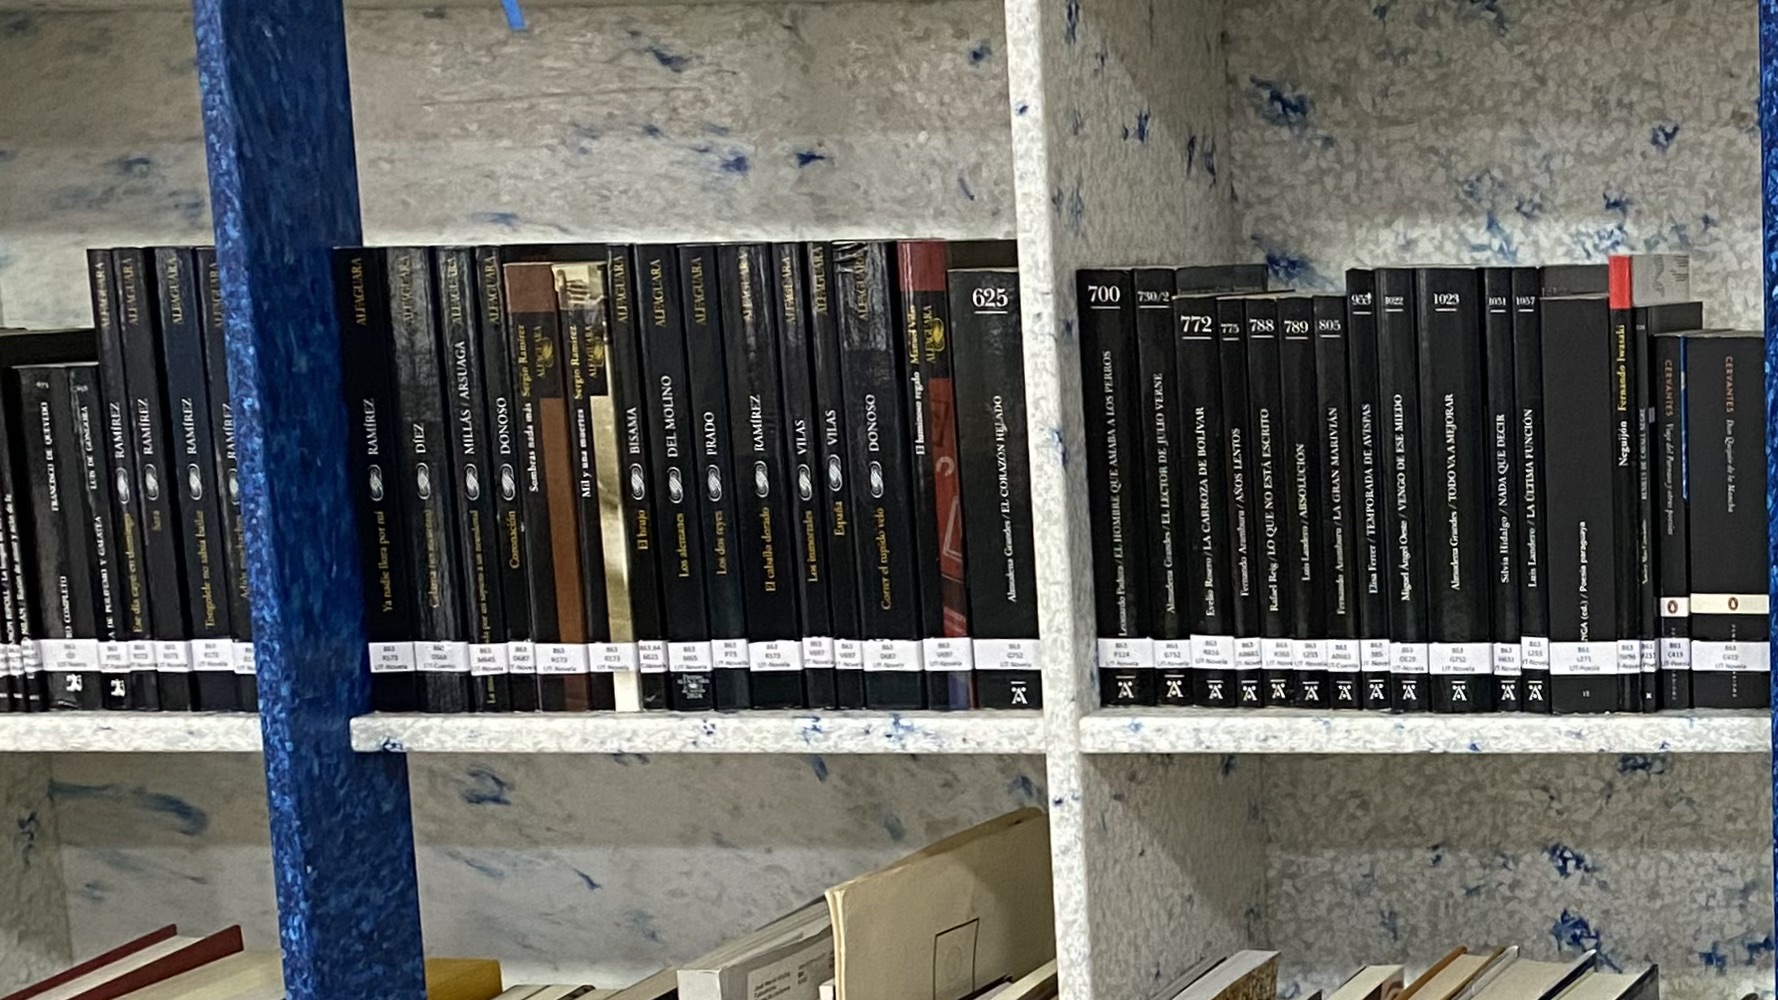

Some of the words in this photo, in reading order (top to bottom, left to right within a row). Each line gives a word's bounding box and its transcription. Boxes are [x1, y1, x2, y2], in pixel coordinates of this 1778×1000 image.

[972, 287, 1009, 308] 625
[1087, 285, 1121, 303] 700
[1179, 315, 1213, 333] 772
[660, 376, 677, 430] MOLINO
[182, 398, 198, 454] RAMÍREZ
[363, 399, 379, 455] RAMÍREZ
[412, 423, 427, 453] DÍEZ
[496, 397, 512, 454] DONOSO
[626, 407, 640, 454] BISAMA
[665, 433, 679, 457] DEL
[703, 411, 717, 455] PRADO
[794, 420, 808, 455] VILAS
[1194, 406, 1209, 457] BOLÍVAR
[1198, 460, 1209, 475] DE
[1199, 479, 1212, 532] CARROZA
[1202, 535, 1212, 550] LA
